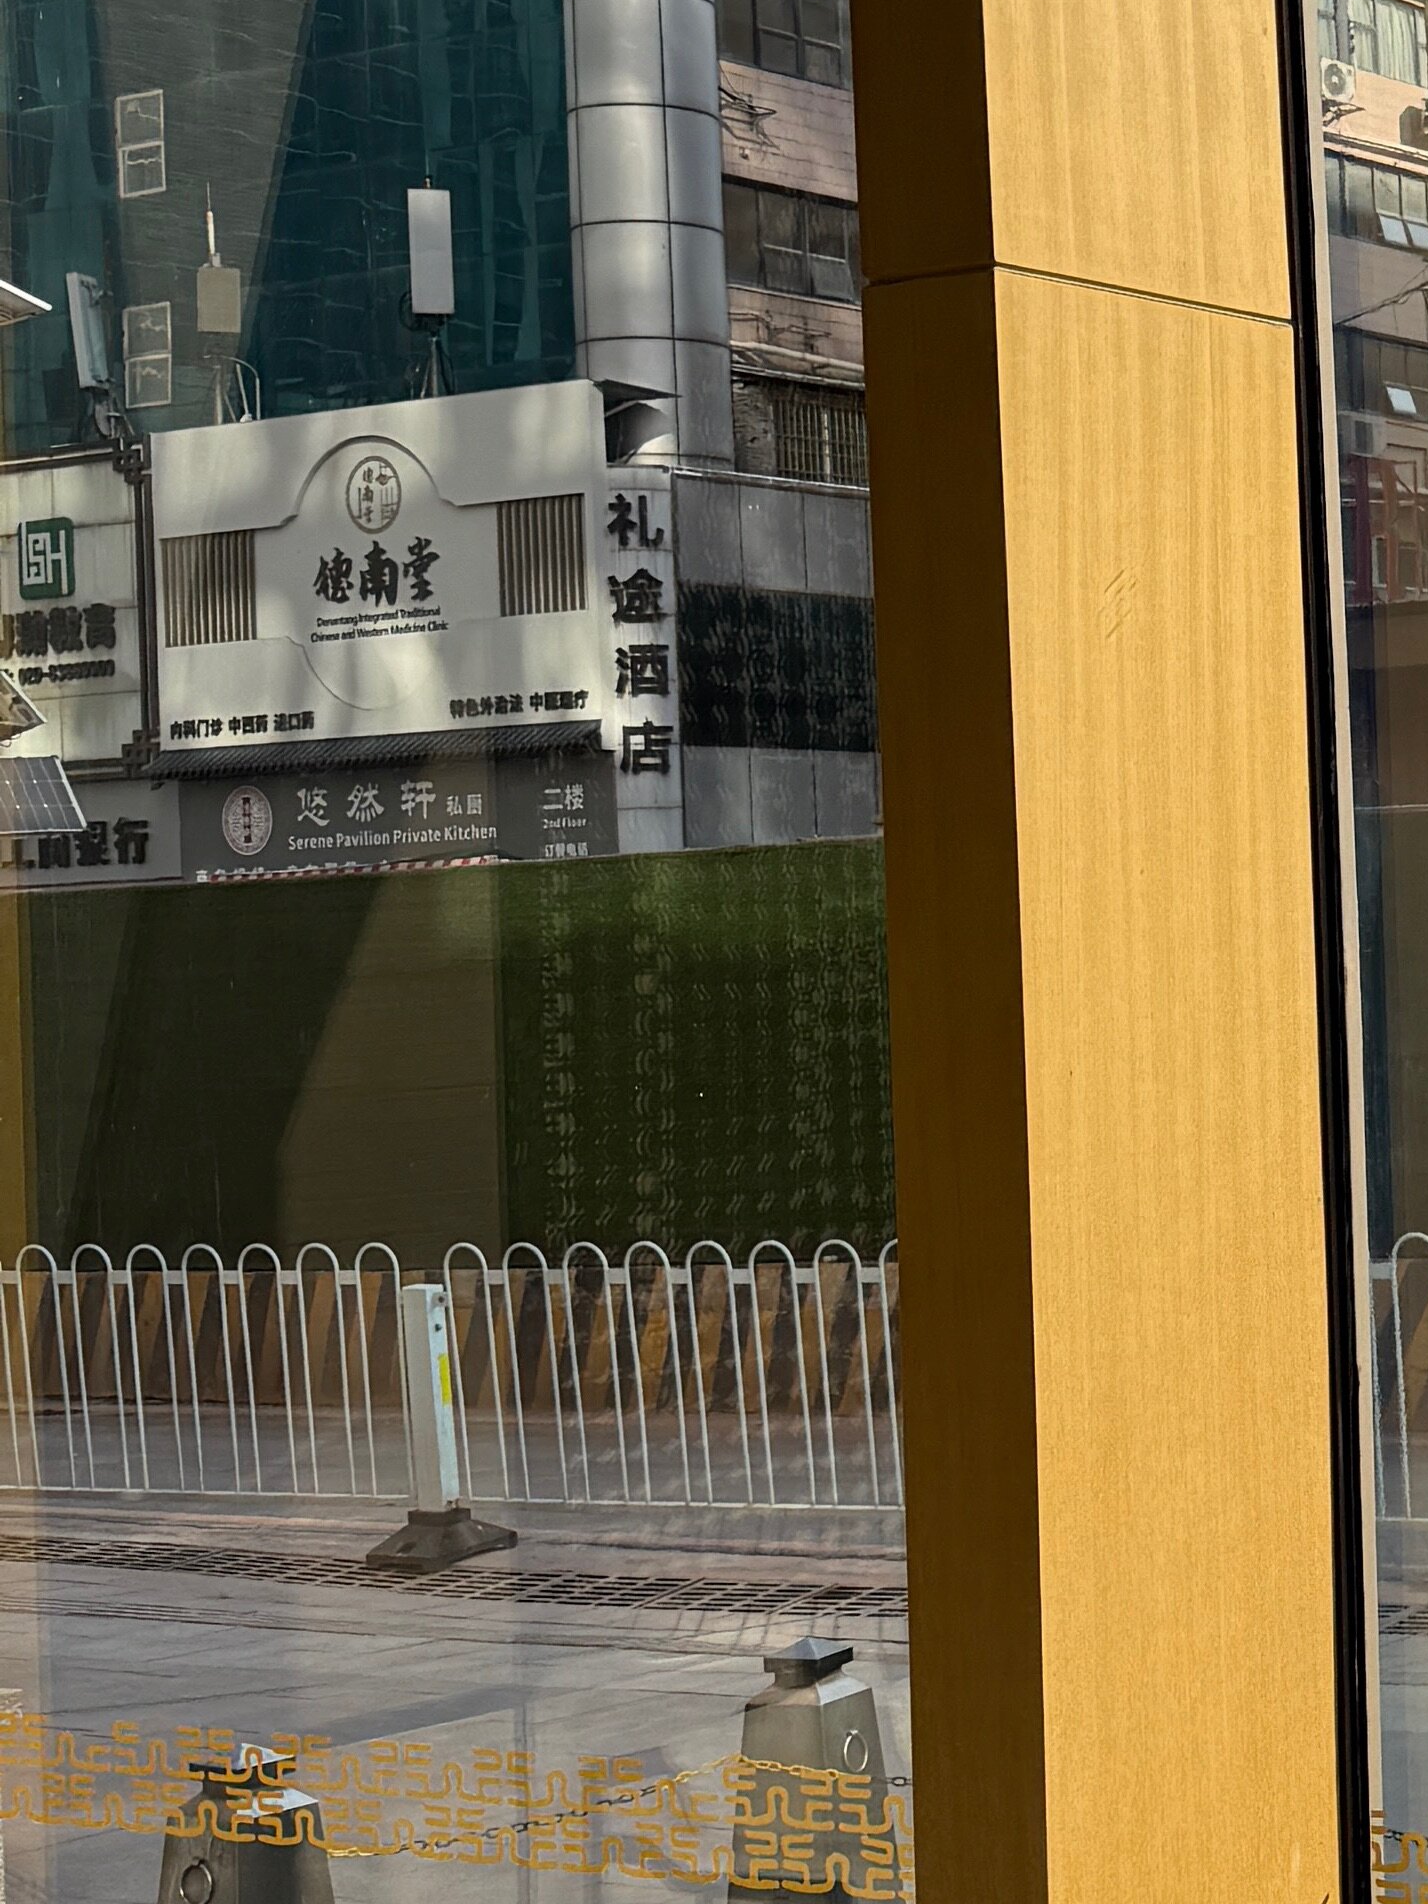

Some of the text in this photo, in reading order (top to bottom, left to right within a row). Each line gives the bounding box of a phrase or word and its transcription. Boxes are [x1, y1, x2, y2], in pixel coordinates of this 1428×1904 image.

[313, 536, 441, 607] 德南堂
[607, 493, 674, 775] 礼途酒店
[296, 780, 436, 827] 悠然轩
[542, 783, 585, 811] 二楼
[288, 823, 498, 851] Serene Pavilion Private Kitchen
